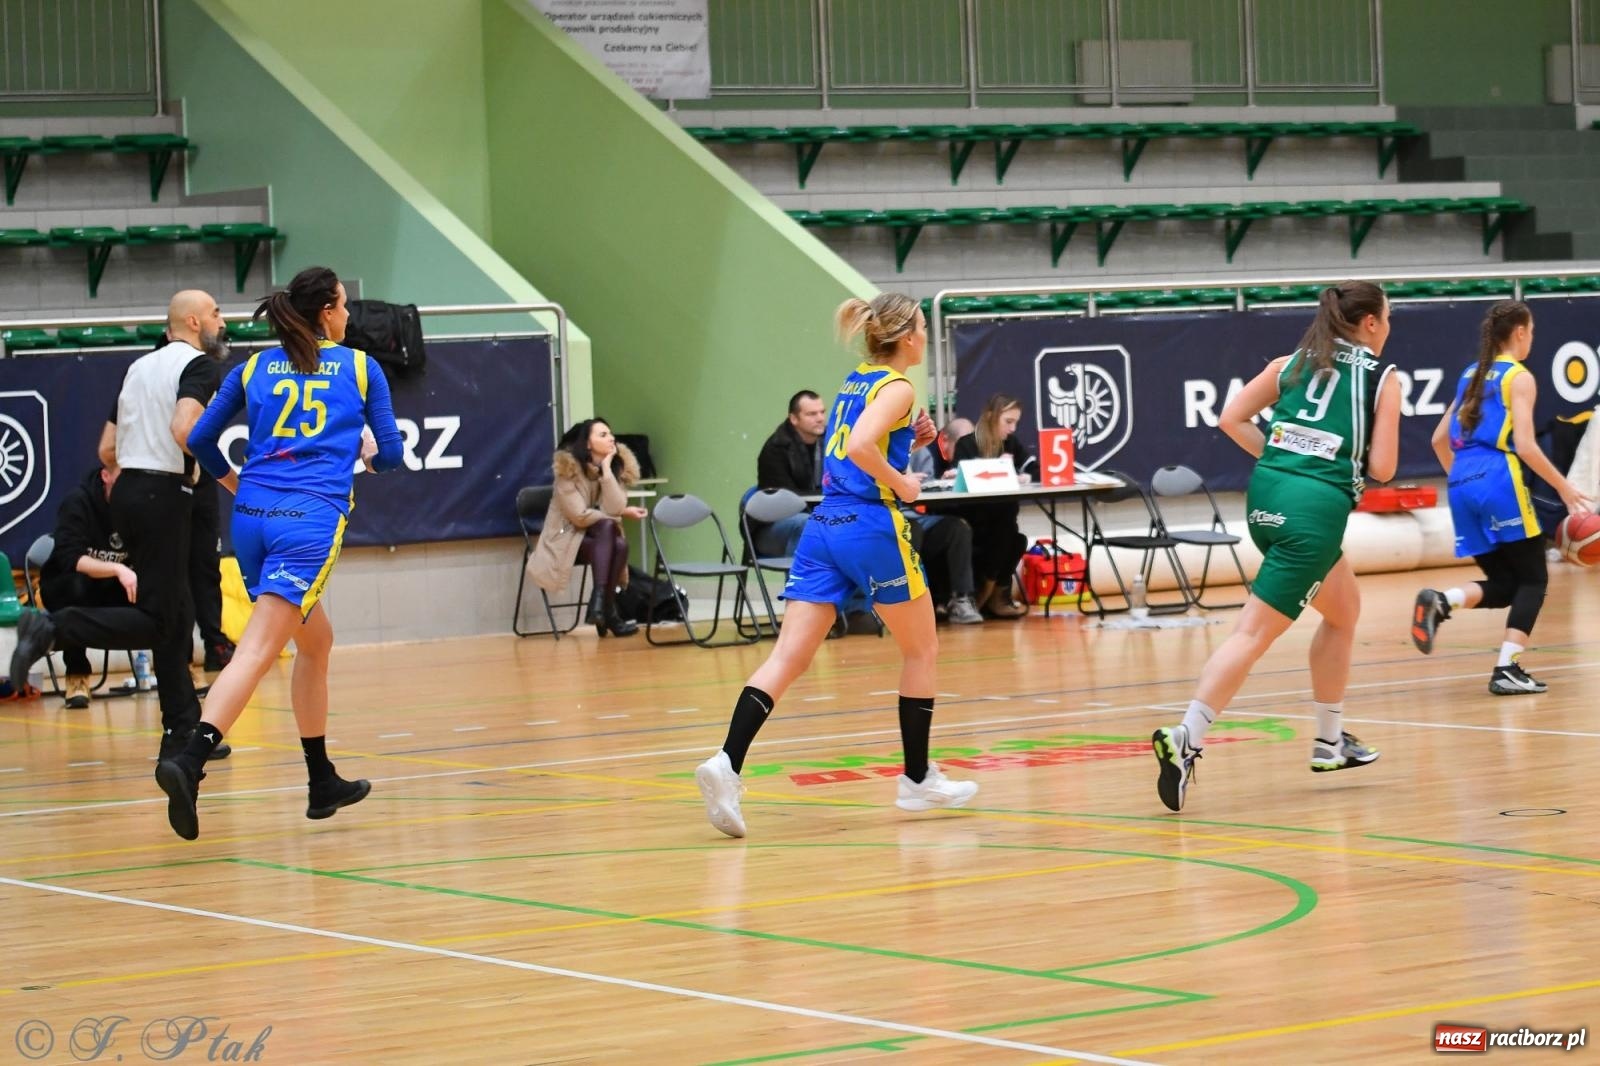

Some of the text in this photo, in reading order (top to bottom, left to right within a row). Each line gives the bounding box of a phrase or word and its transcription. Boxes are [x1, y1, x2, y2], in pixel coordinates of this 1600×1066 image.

[561, 25, 660, 35] cownik produkcyjny
[604, 43, 647, 53] Czekamy
[651, 44, 662, 52] na
[272, 378, 330, 438] 25
[1296, 367, 1341, 422] 9
[1047, 434, 1069, 474] 5
